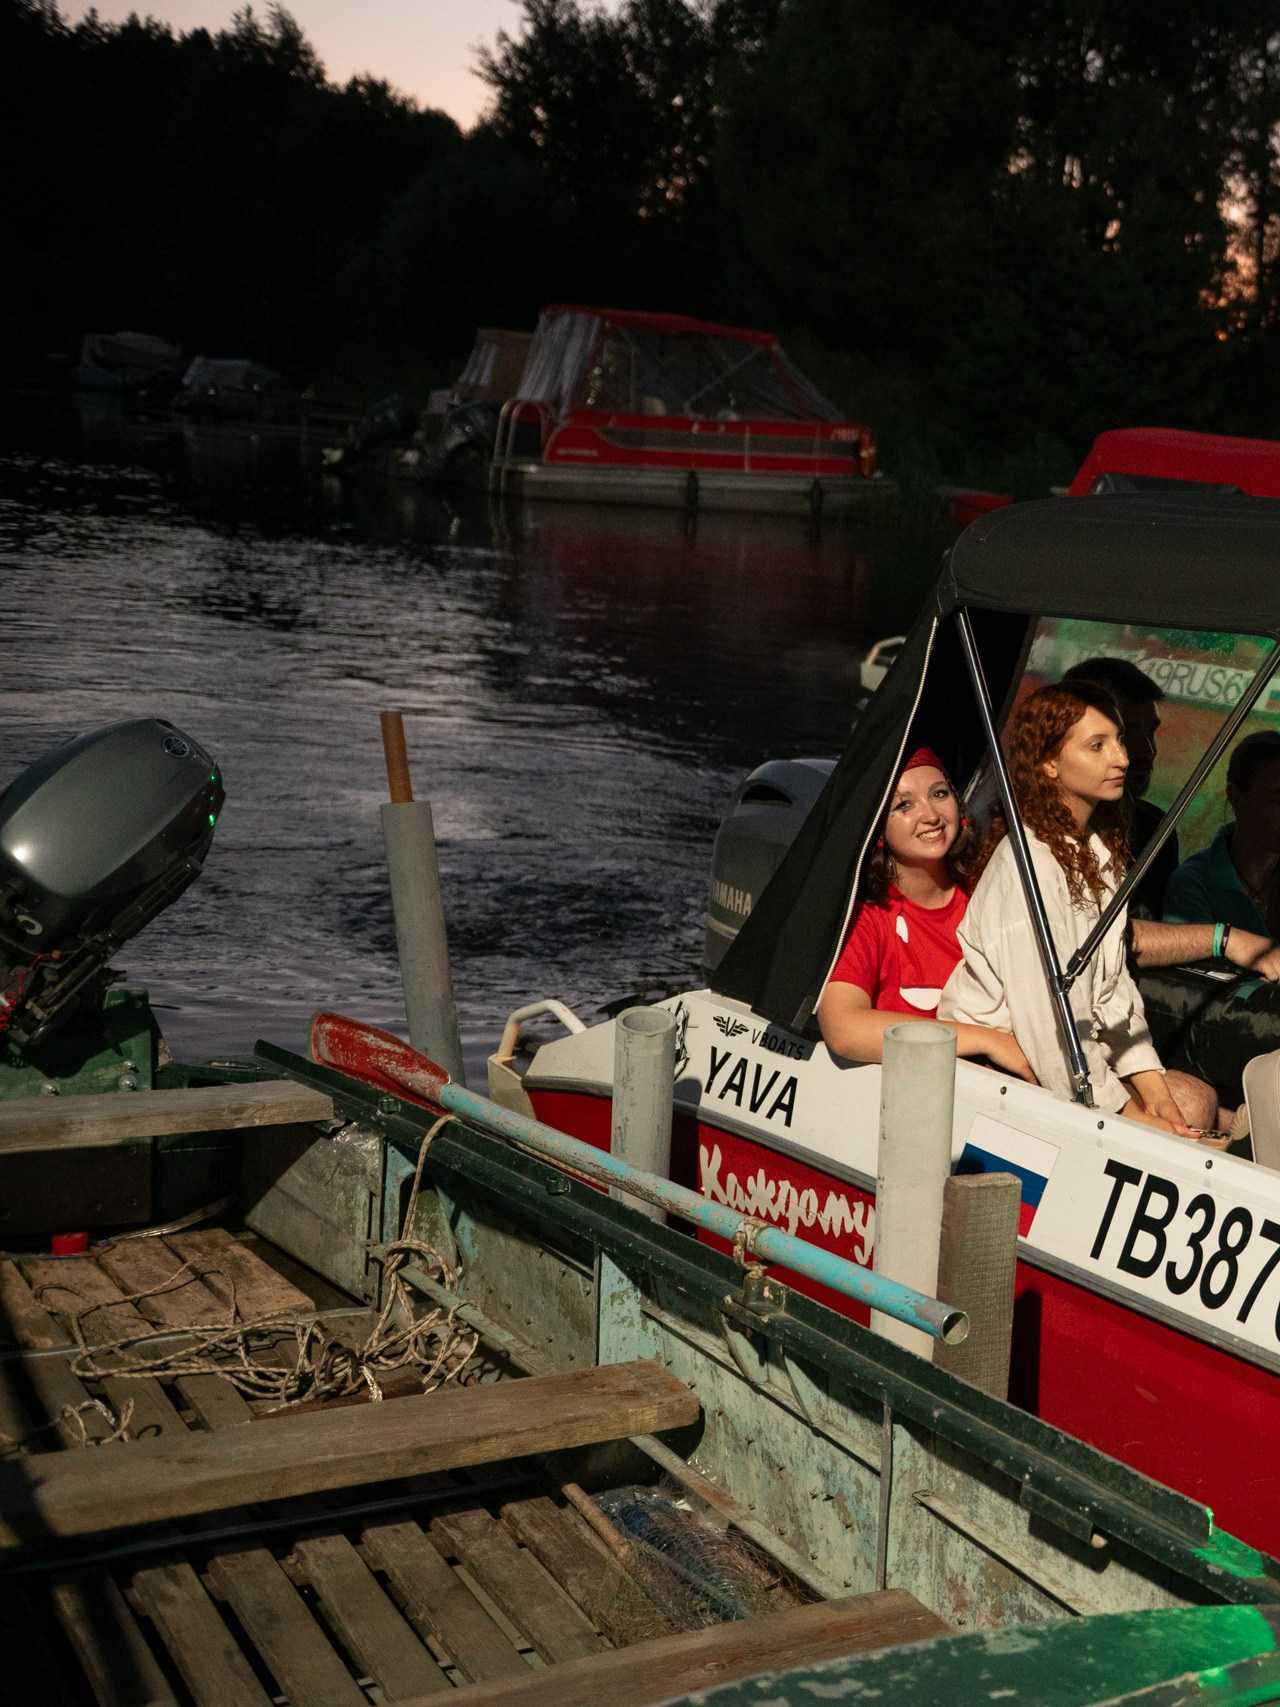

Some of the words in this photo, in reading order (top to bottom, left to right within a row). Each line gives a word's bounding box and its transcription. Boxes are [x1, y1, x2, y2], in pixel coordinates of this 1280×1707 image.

[711, 879, 752, 916] YAMAHA
[751, 1028, 805, 1060] VBOATS
[704, 1046, 798, 1128] YAVA
[699, 1143, 876, 1266] Каждому
